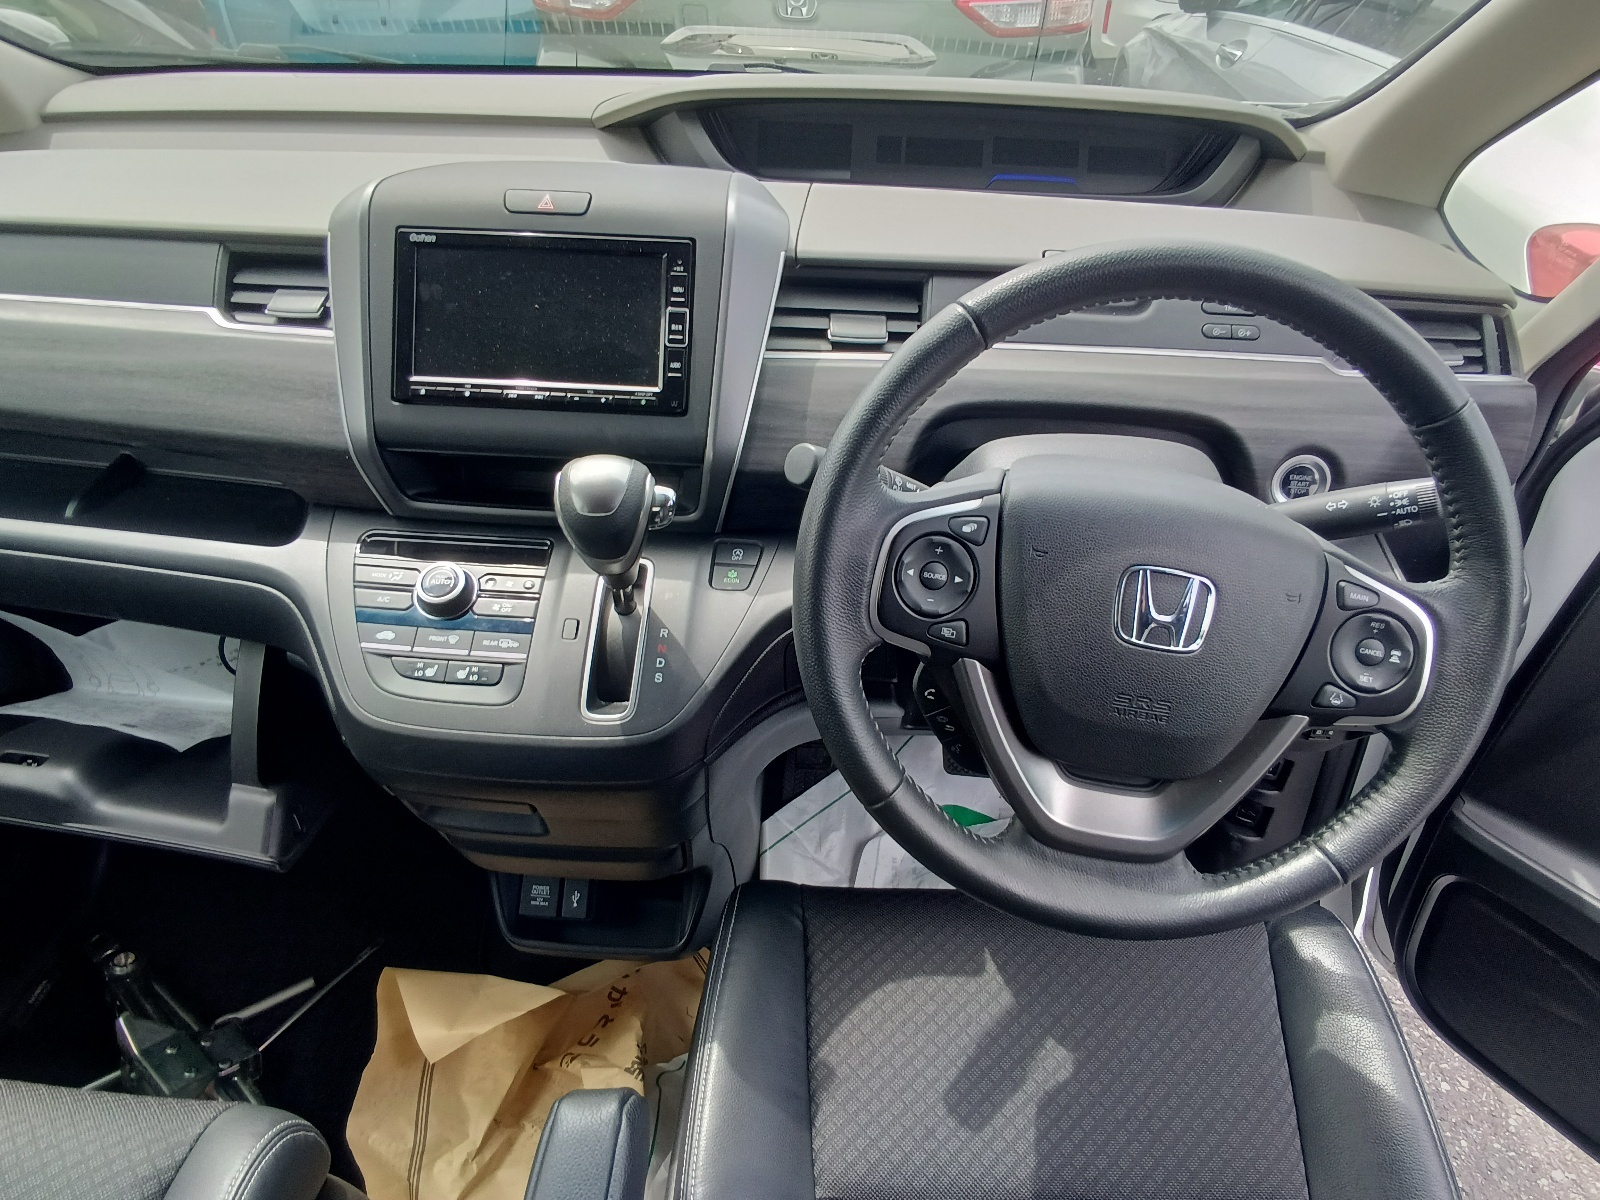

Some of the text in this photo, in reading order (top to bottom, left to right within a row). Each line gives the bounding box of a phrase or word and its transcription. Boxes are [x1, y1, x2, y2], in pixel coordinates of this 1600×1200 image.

[1289, 474, 1313, 482] ENGINE
[1393, 490, 1409, 499] OFF
[1396, 505, 1419, 516] AUTO
[923, 571, 947, 581] SOURCE
[430, 578, 451, 586] AUTO
[1349, 592, 1369, 602] MAIN
[1370, 621, 1386, 630] RES
[659, 628, 669, 638] R
[482, 639, 498, 647] REAR
[657, 643, 667, 653] N
[1359, 647, 1383, 658] CANCEL
[656, 658, 666, 668] D
[654, 672, 663, 683] S
[1359, 675, 1374, 683] SET
[1112, 694, 1172, 715] SRS
[1112, 707, 1169, 725] AIRBAG
